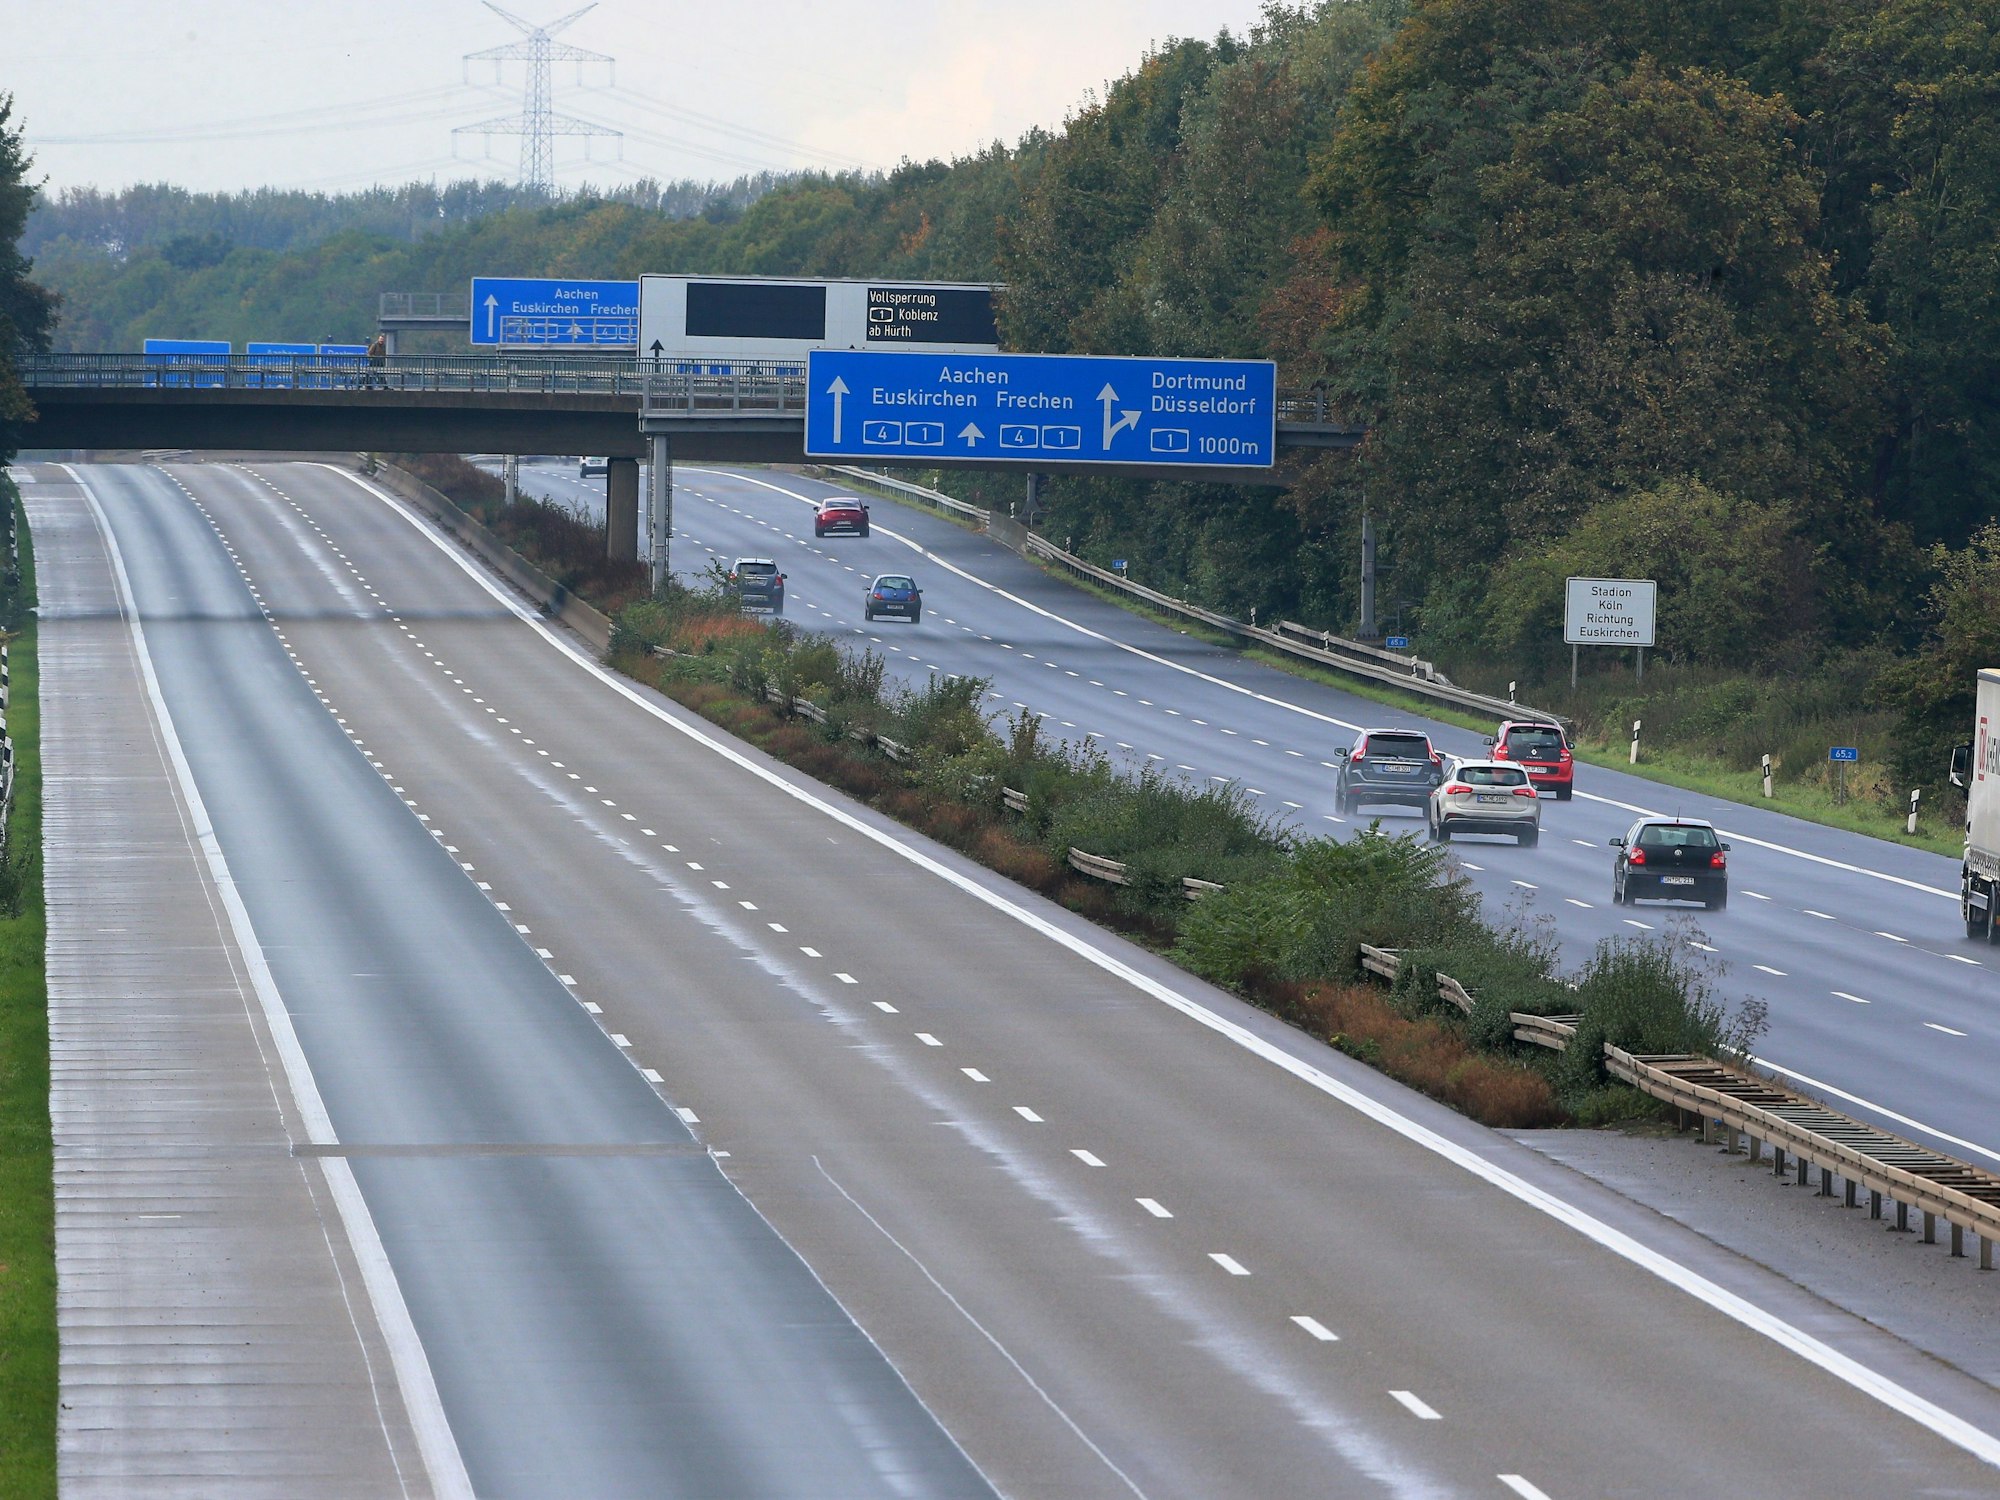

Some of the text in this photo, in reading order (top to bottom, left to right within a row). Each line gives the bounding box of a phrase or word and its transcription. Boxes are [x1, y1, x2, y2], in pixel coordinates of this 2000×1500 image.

[555, 288, 599, 300] Aachen
[869, 290, 936, 307] Vollsperrung
[512, 301, 638, 315] Euskirchen Frechen
[879, 308, 939, 321] 1 Koblenz
[868, 324, 912, 337] ab Hürth
[939, 366, 1009, 385] Aachen
[1152, 372, 1246, 391] Dortmund
[872, 387, 1073, 409] Euskirchen Frechen
[1151, 395, 1256, 414] Düsseldorf
[877, 425, 928, 441] 4 1
[1014, 429, 1065, 445] 4 1
[1167, 433, 1259, 455] 1 1000m
[1591, 586, 1632, 597] Stadion
[1598, 600, 1623, 610] Köln
[1586, 613, 1634, 627] Richtung
[1579, 626, 1640, 638] Euskirchen
[1835, 749, 1853, 759] 65.2
